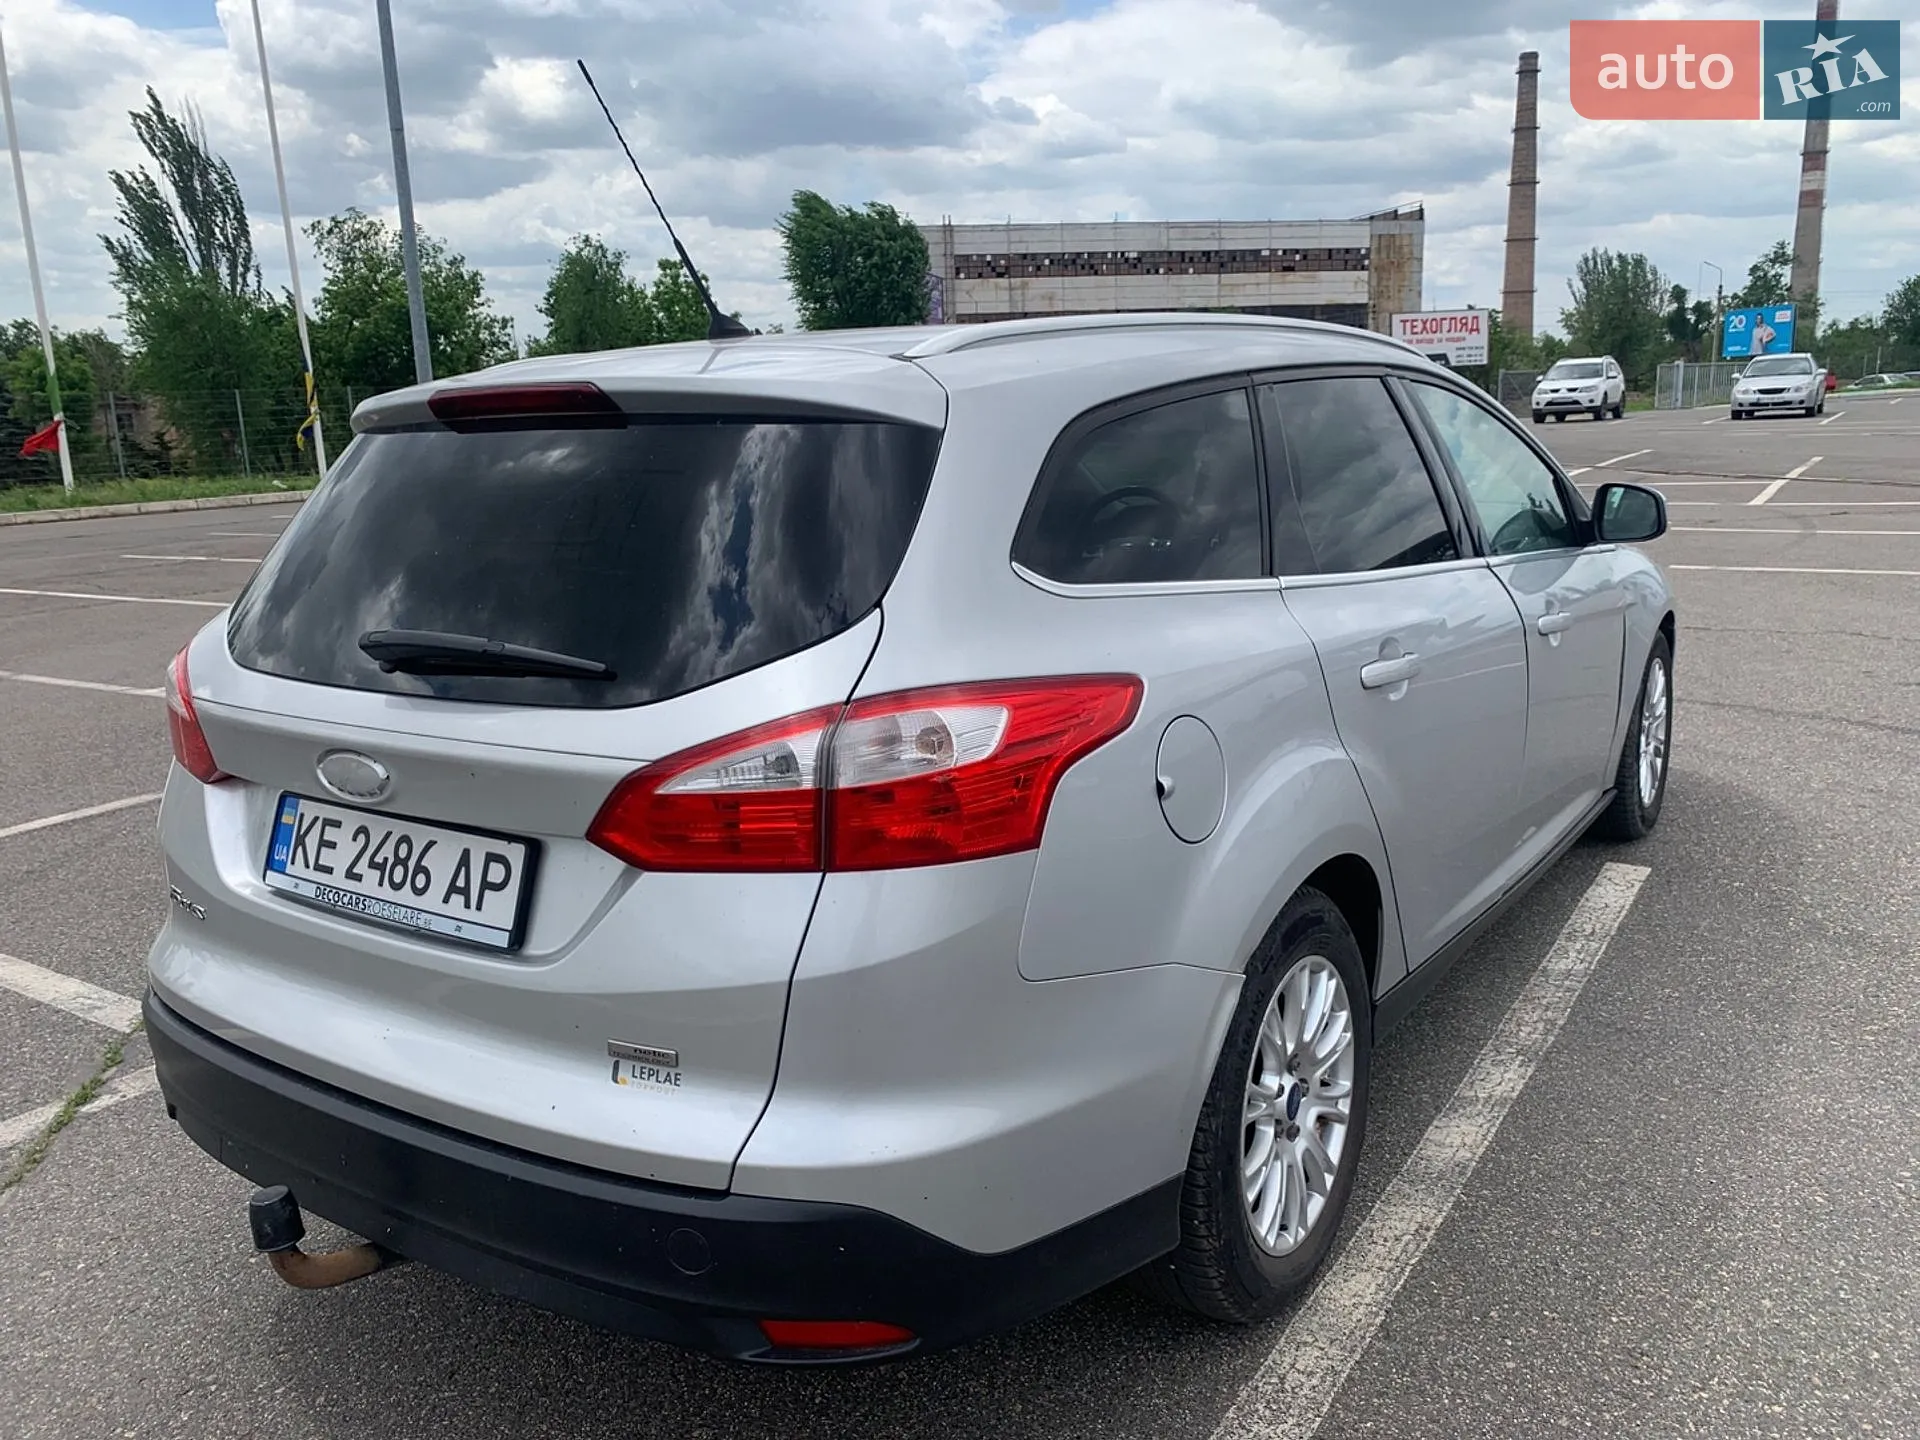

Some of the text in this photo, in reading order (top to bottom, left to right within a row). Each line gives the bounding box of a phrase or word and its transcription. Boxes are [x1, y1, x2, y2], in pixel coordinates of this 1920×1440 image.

[1400, 315, 1480, 336] ТЕХОГЛЯД
[274, 845, 288, 863] UA
[290, 812, 512, 912] KE 2486 AP
[631, 1064, 682, 1087] LEPLAE
